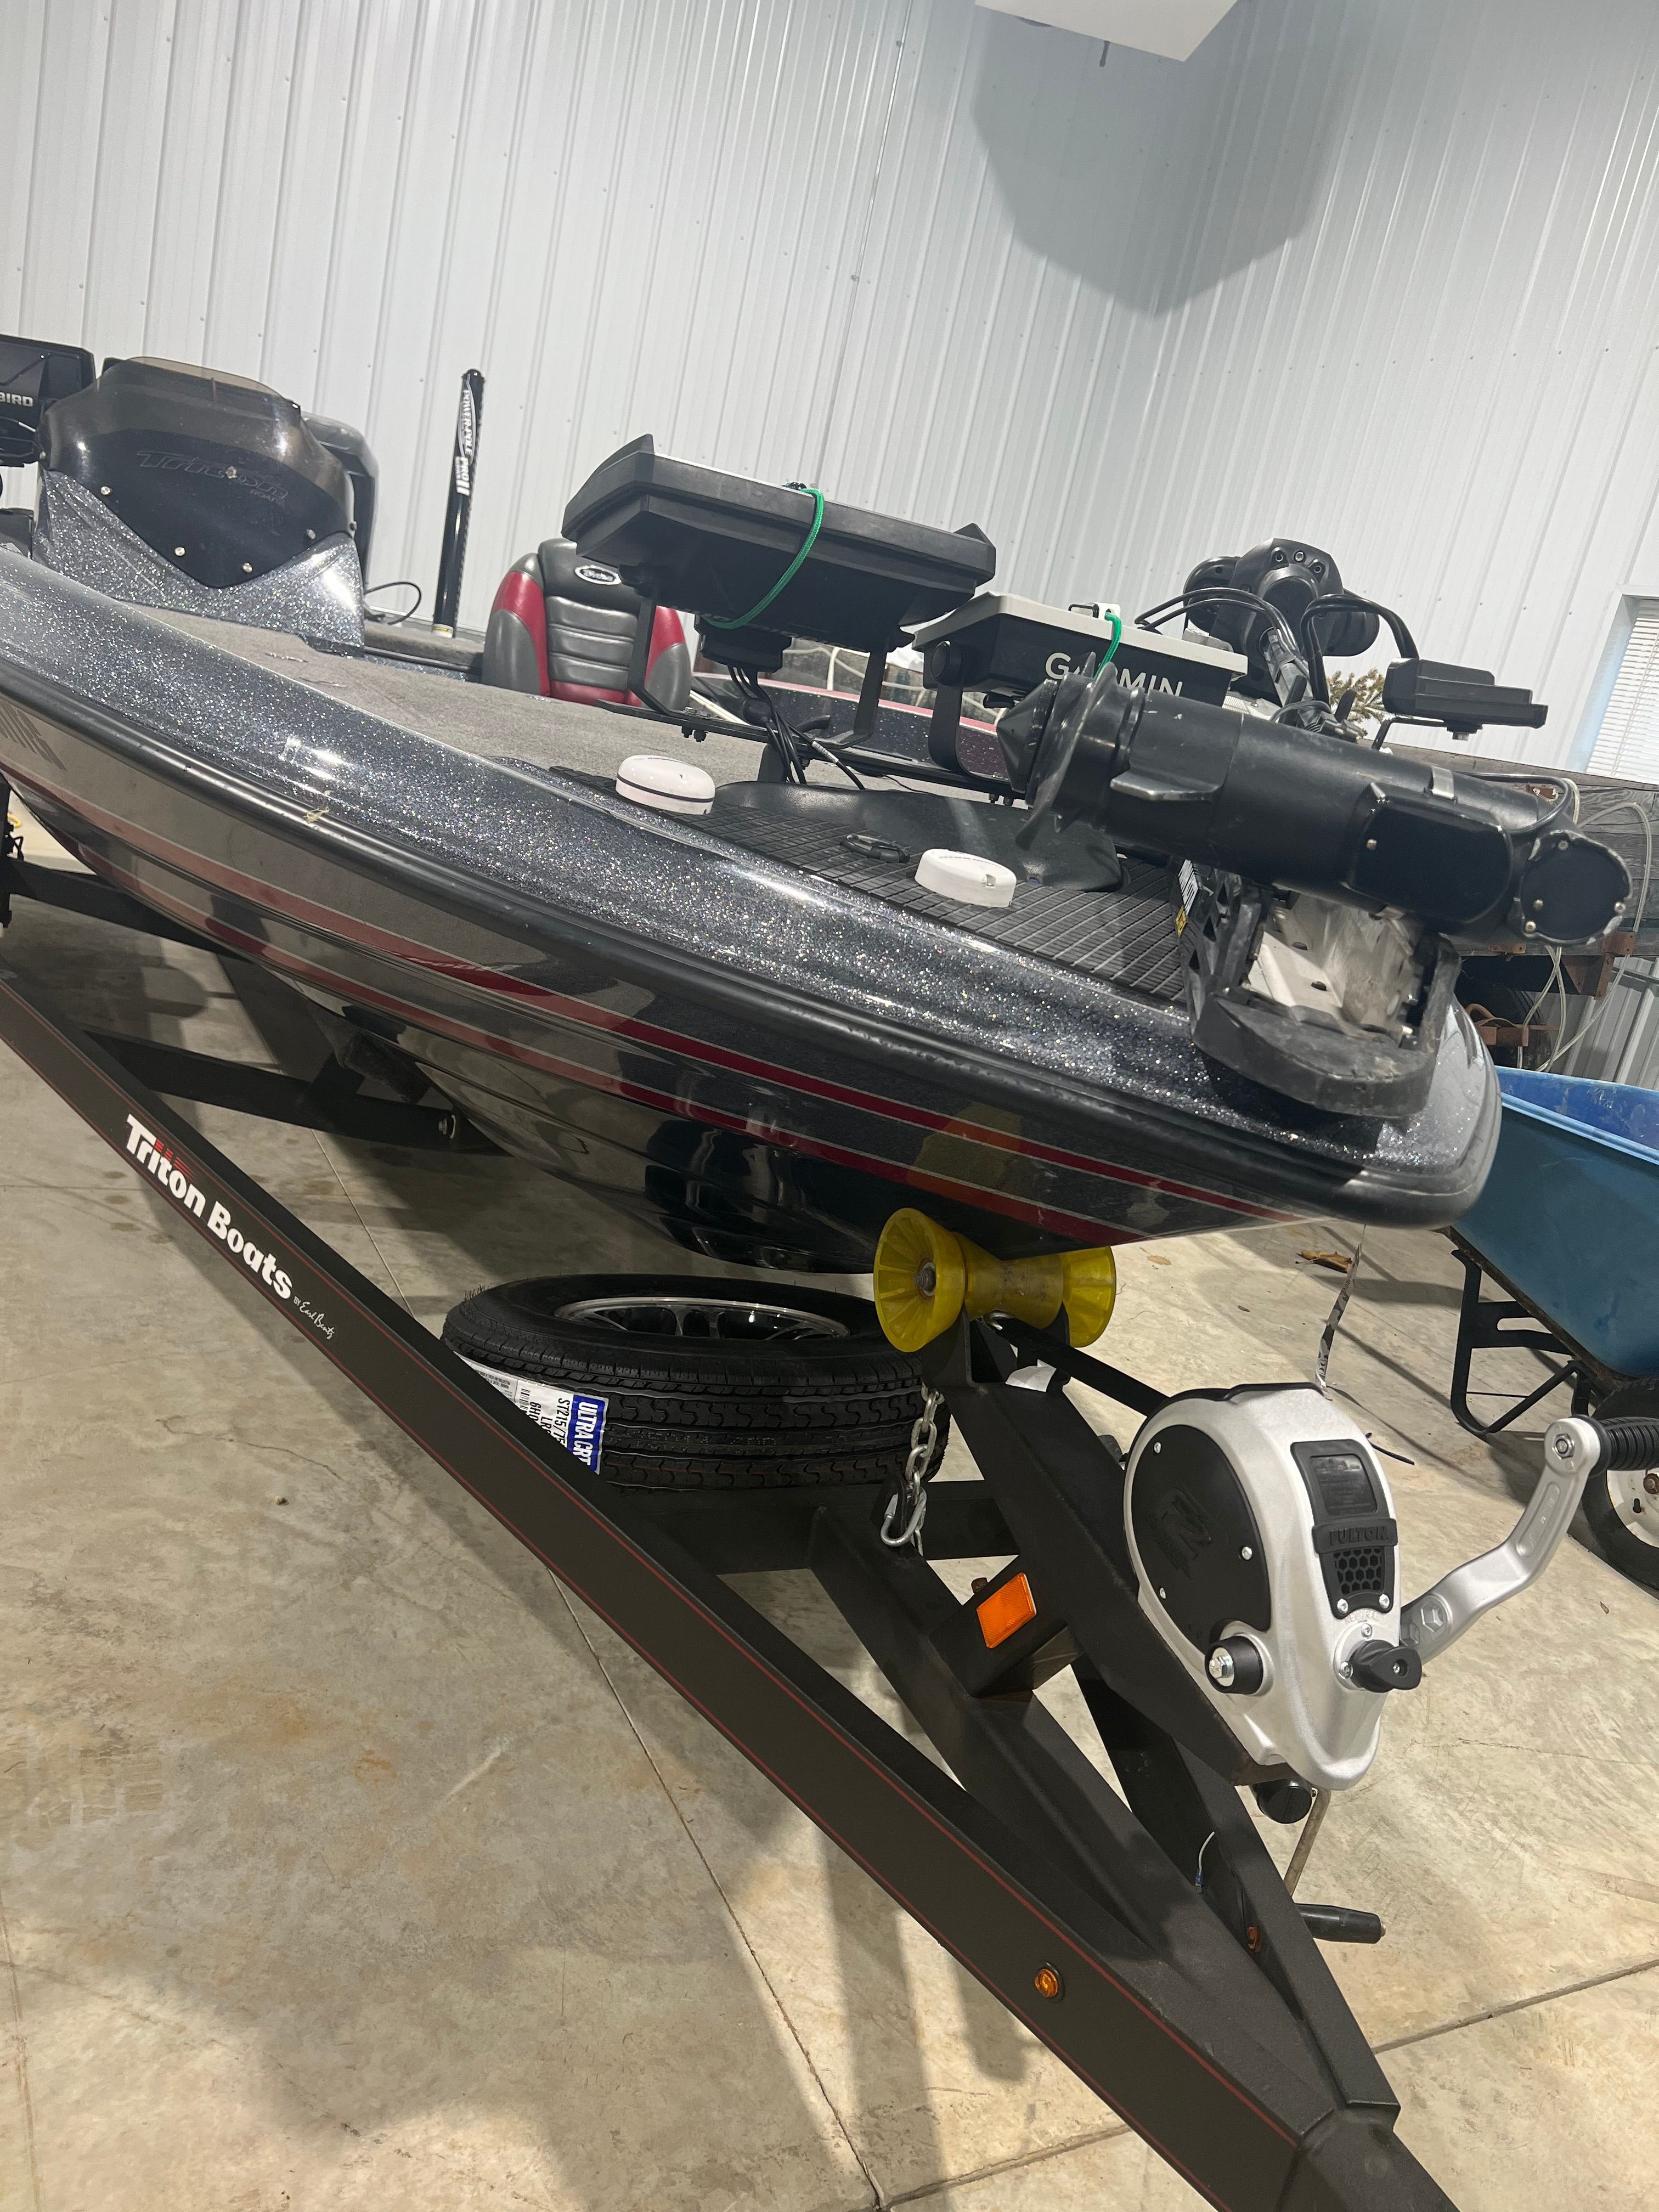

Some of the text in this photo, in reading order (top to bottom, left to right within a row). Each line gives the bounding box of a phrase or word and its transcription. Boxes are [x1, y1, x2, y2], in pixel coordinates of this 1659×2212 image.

[1045, 652, 1183, 697] GMIN
[126, 1114, 206, 1218] Triton
[207, 1201, 293, 1299] Boats
[300, 1301, 317, 1320] Earl
[574, 1401, 599, 1440] ULTRA
